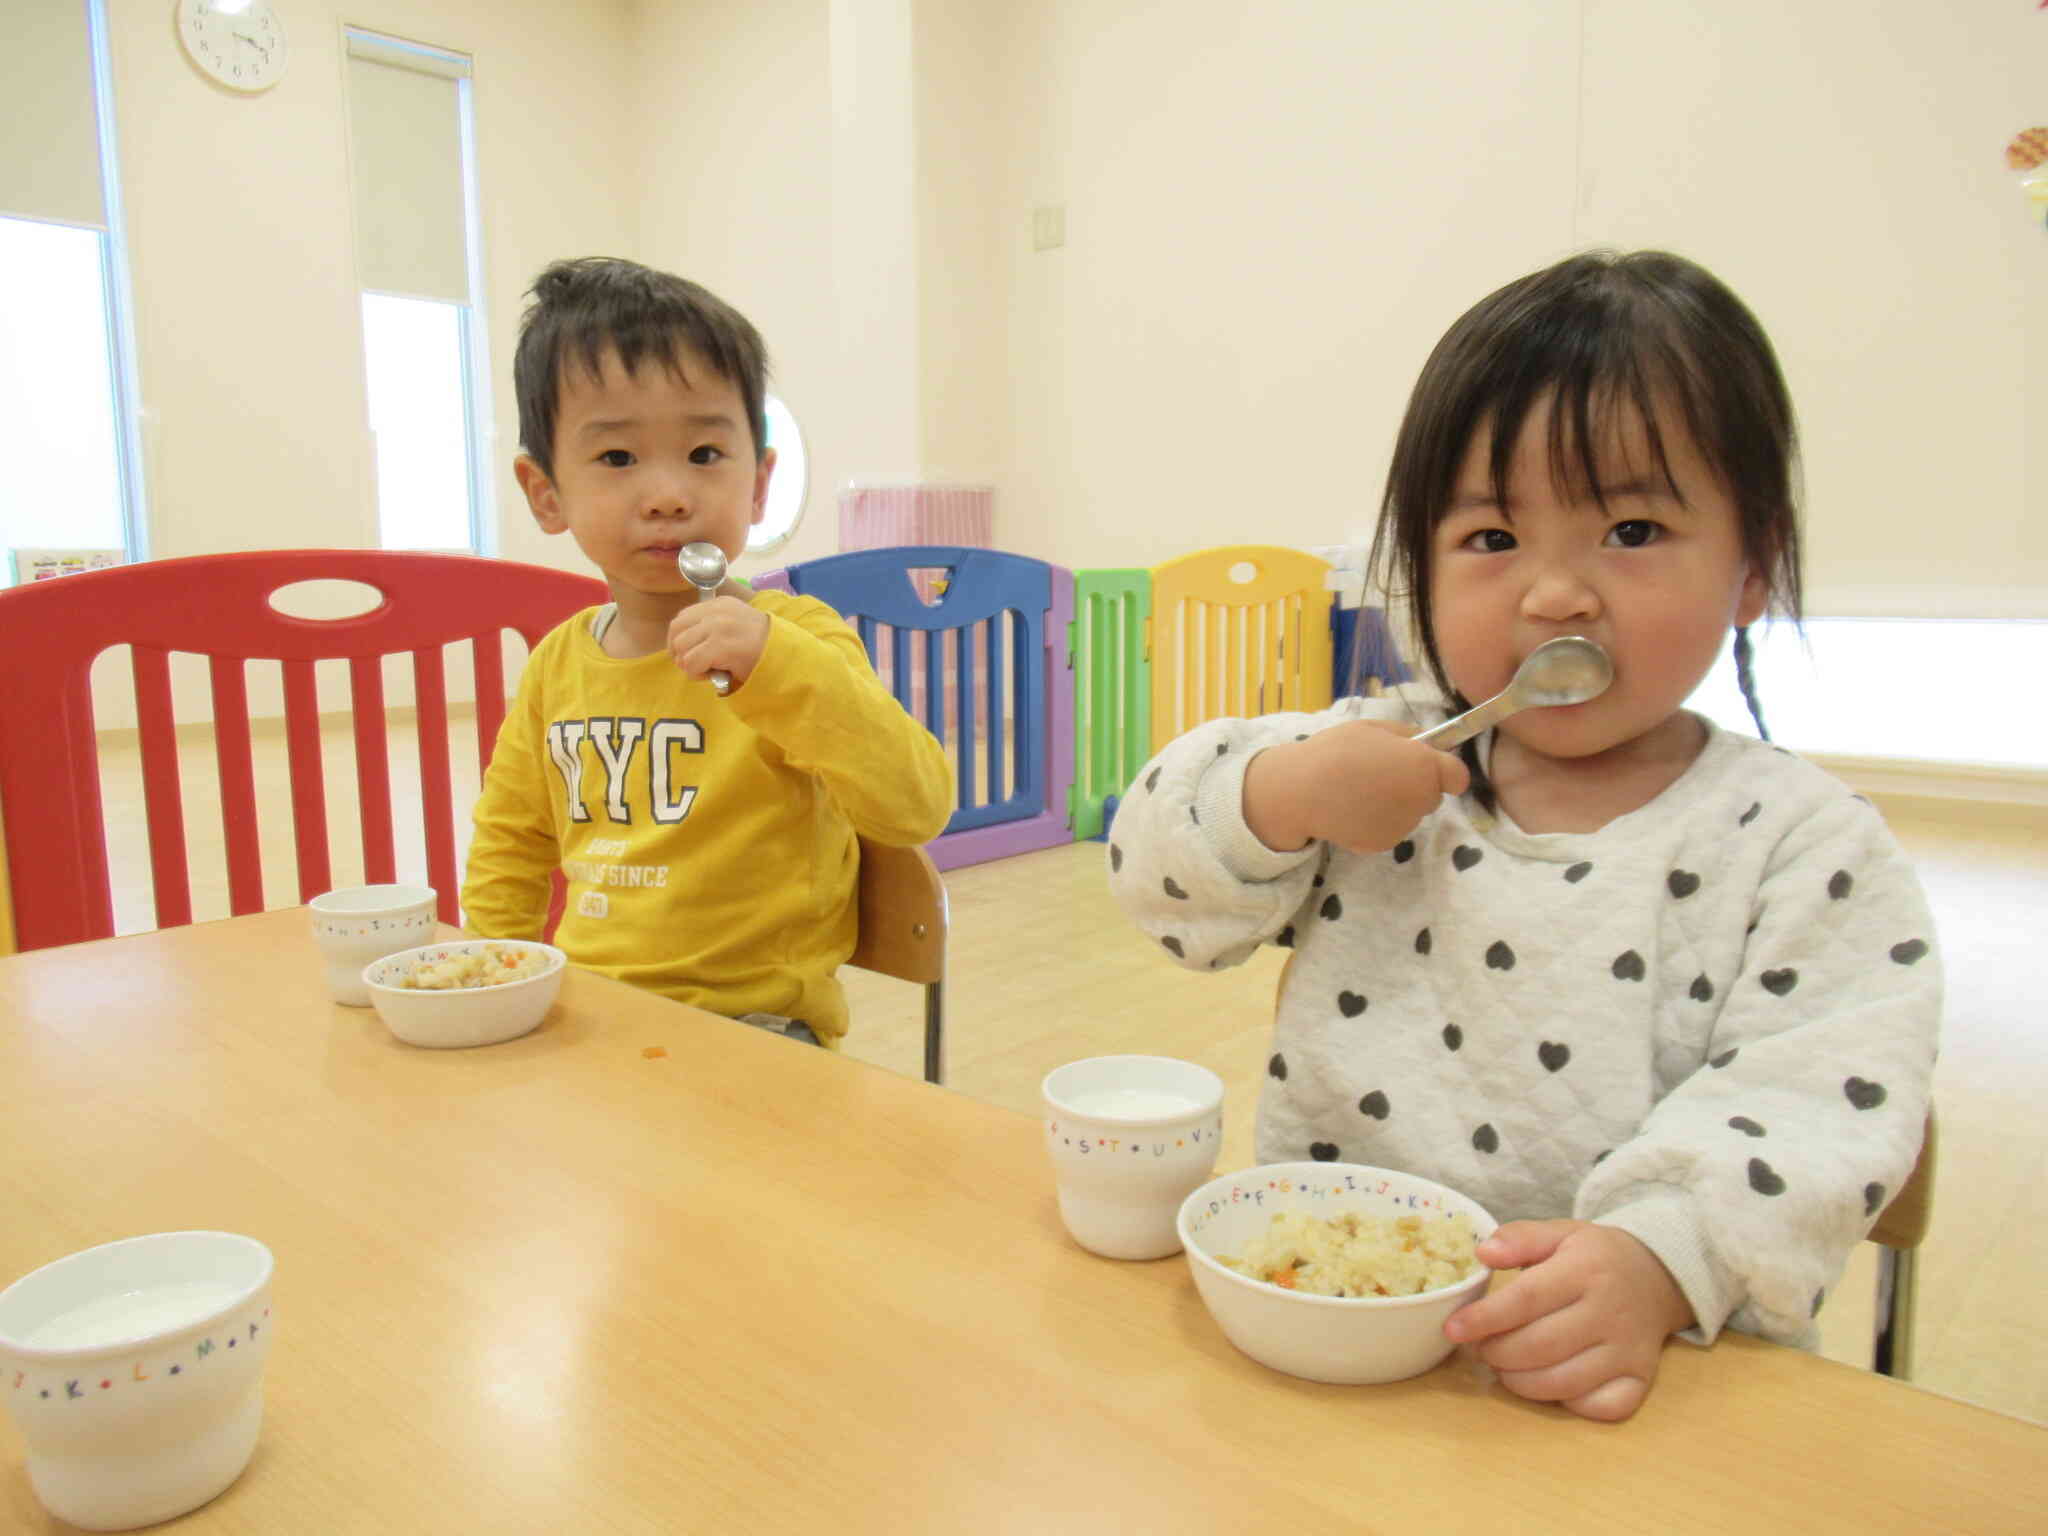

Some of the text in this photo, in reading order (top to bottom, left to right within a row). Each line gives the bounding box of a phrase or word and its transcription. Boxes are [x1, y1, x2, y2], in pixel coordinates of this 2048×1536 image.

[547, 717, 705, 825] NYC
[607, 864, 669, 888] SINCE
[1079, 1139, 1090, 1154] S
[1109, 1140, 1120, 1153] T
[1153, 1143, 1165, 1157] U
[65, 1379, 83, 1400] K
[133, 1362, 152, 1382] L
